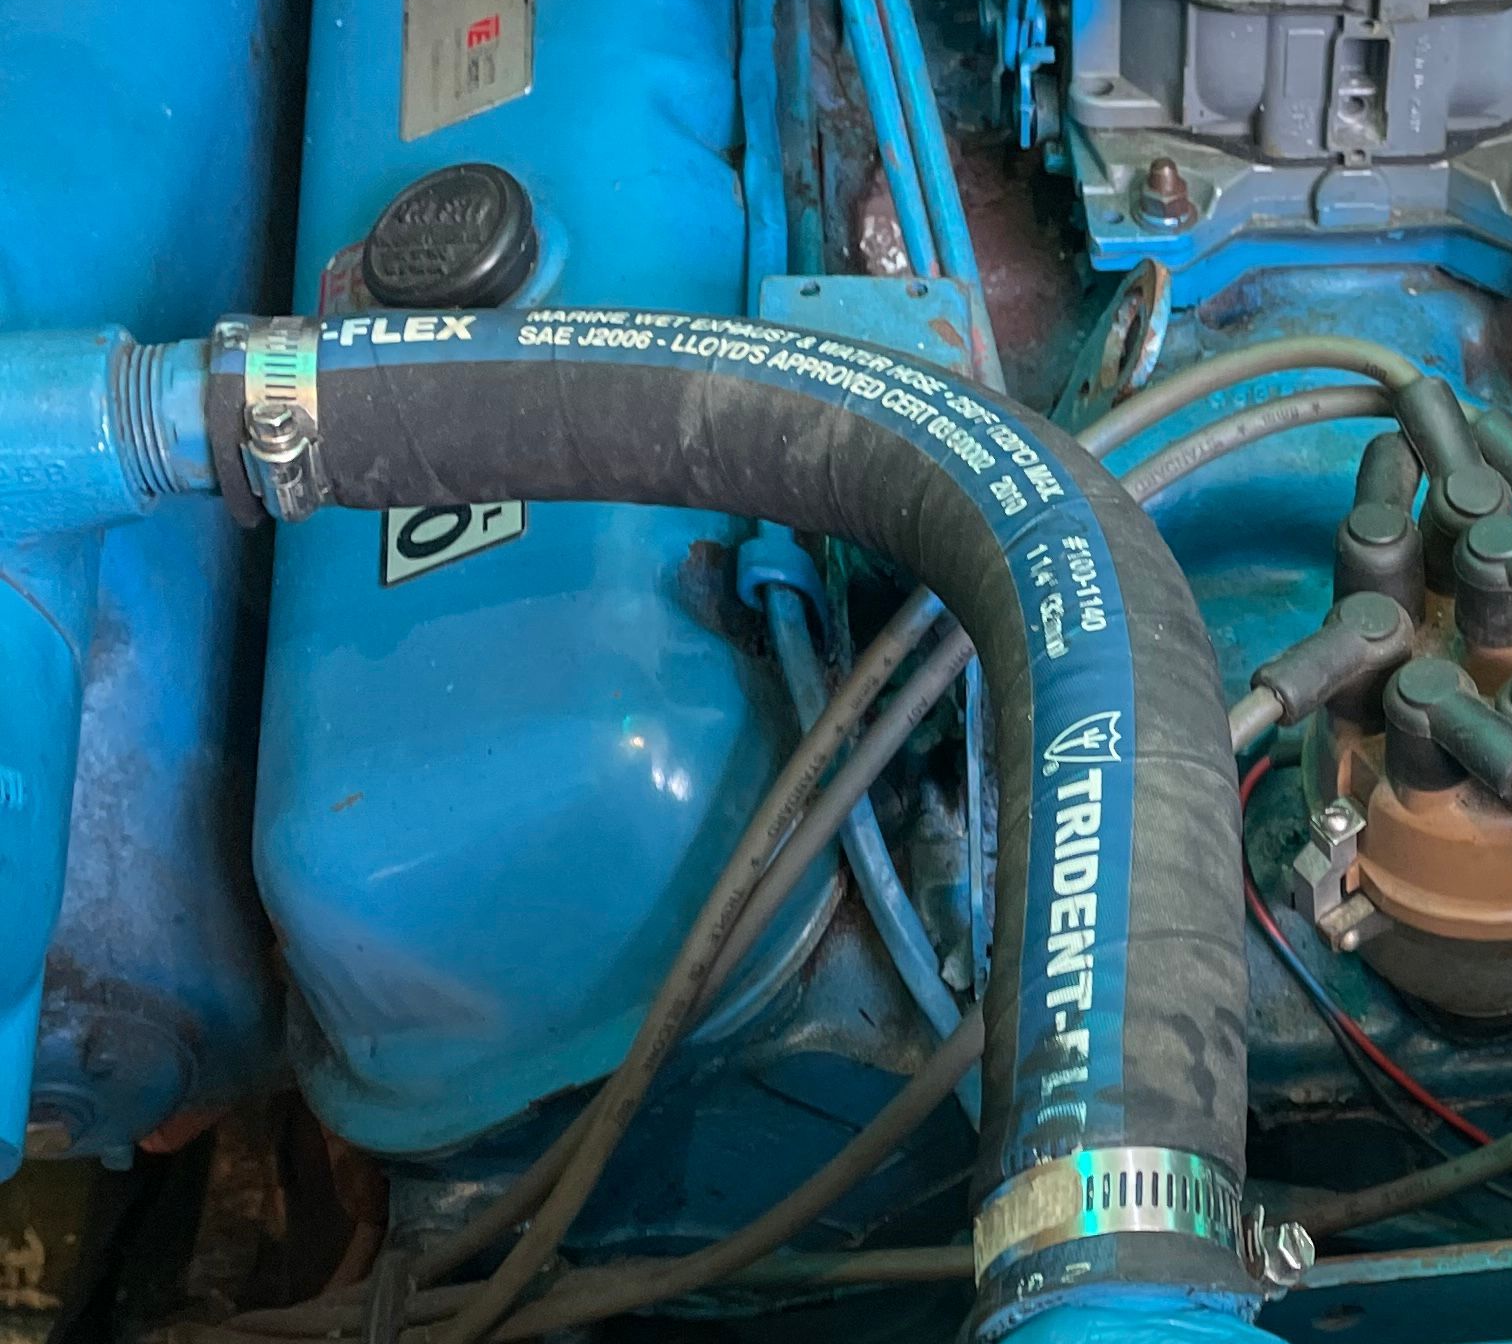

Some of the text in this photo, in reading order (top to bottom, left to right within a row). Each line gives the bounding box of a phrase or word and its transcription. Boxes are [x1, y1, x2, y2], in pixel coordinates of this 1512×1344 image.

[517, 326, 571, 347] SAE
[577, 327, 654, 350] J2006
[766, 349, 886, 400] APPROVED
[881, 387, 939, 425] CERT
[817, 338, 894, 374] WATER
